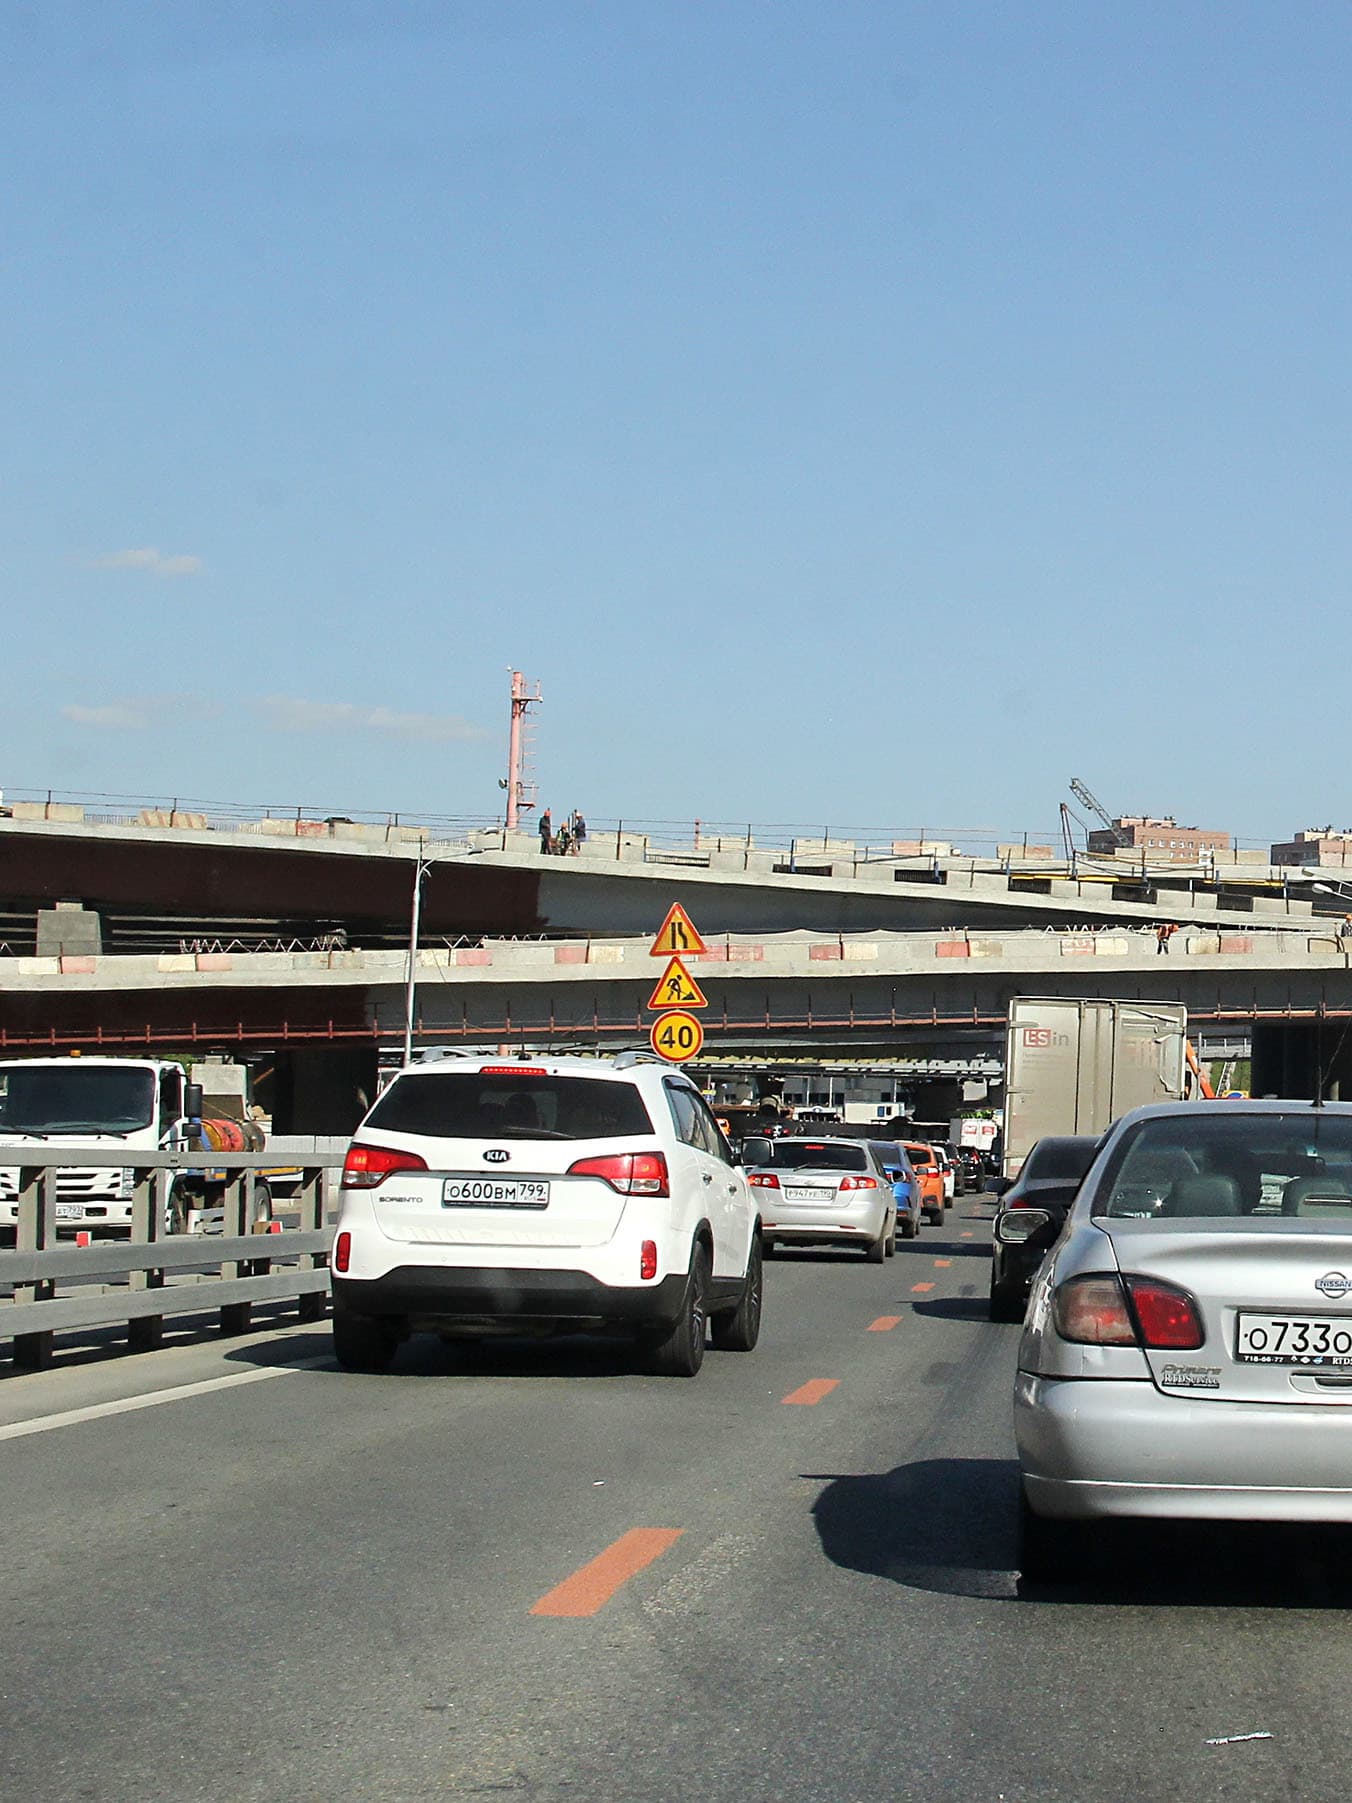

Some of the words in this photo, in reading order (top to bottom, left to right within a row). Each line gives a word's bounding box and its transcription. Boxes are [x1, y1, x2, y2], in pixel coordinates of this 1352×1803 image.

[659, 1025, 693, 1049] 40
[486, 1151, 507, 1161] KIA
[519, 1183, 544, 1196] 799
[1319, 1280, 1352, 1288] NISSAN
